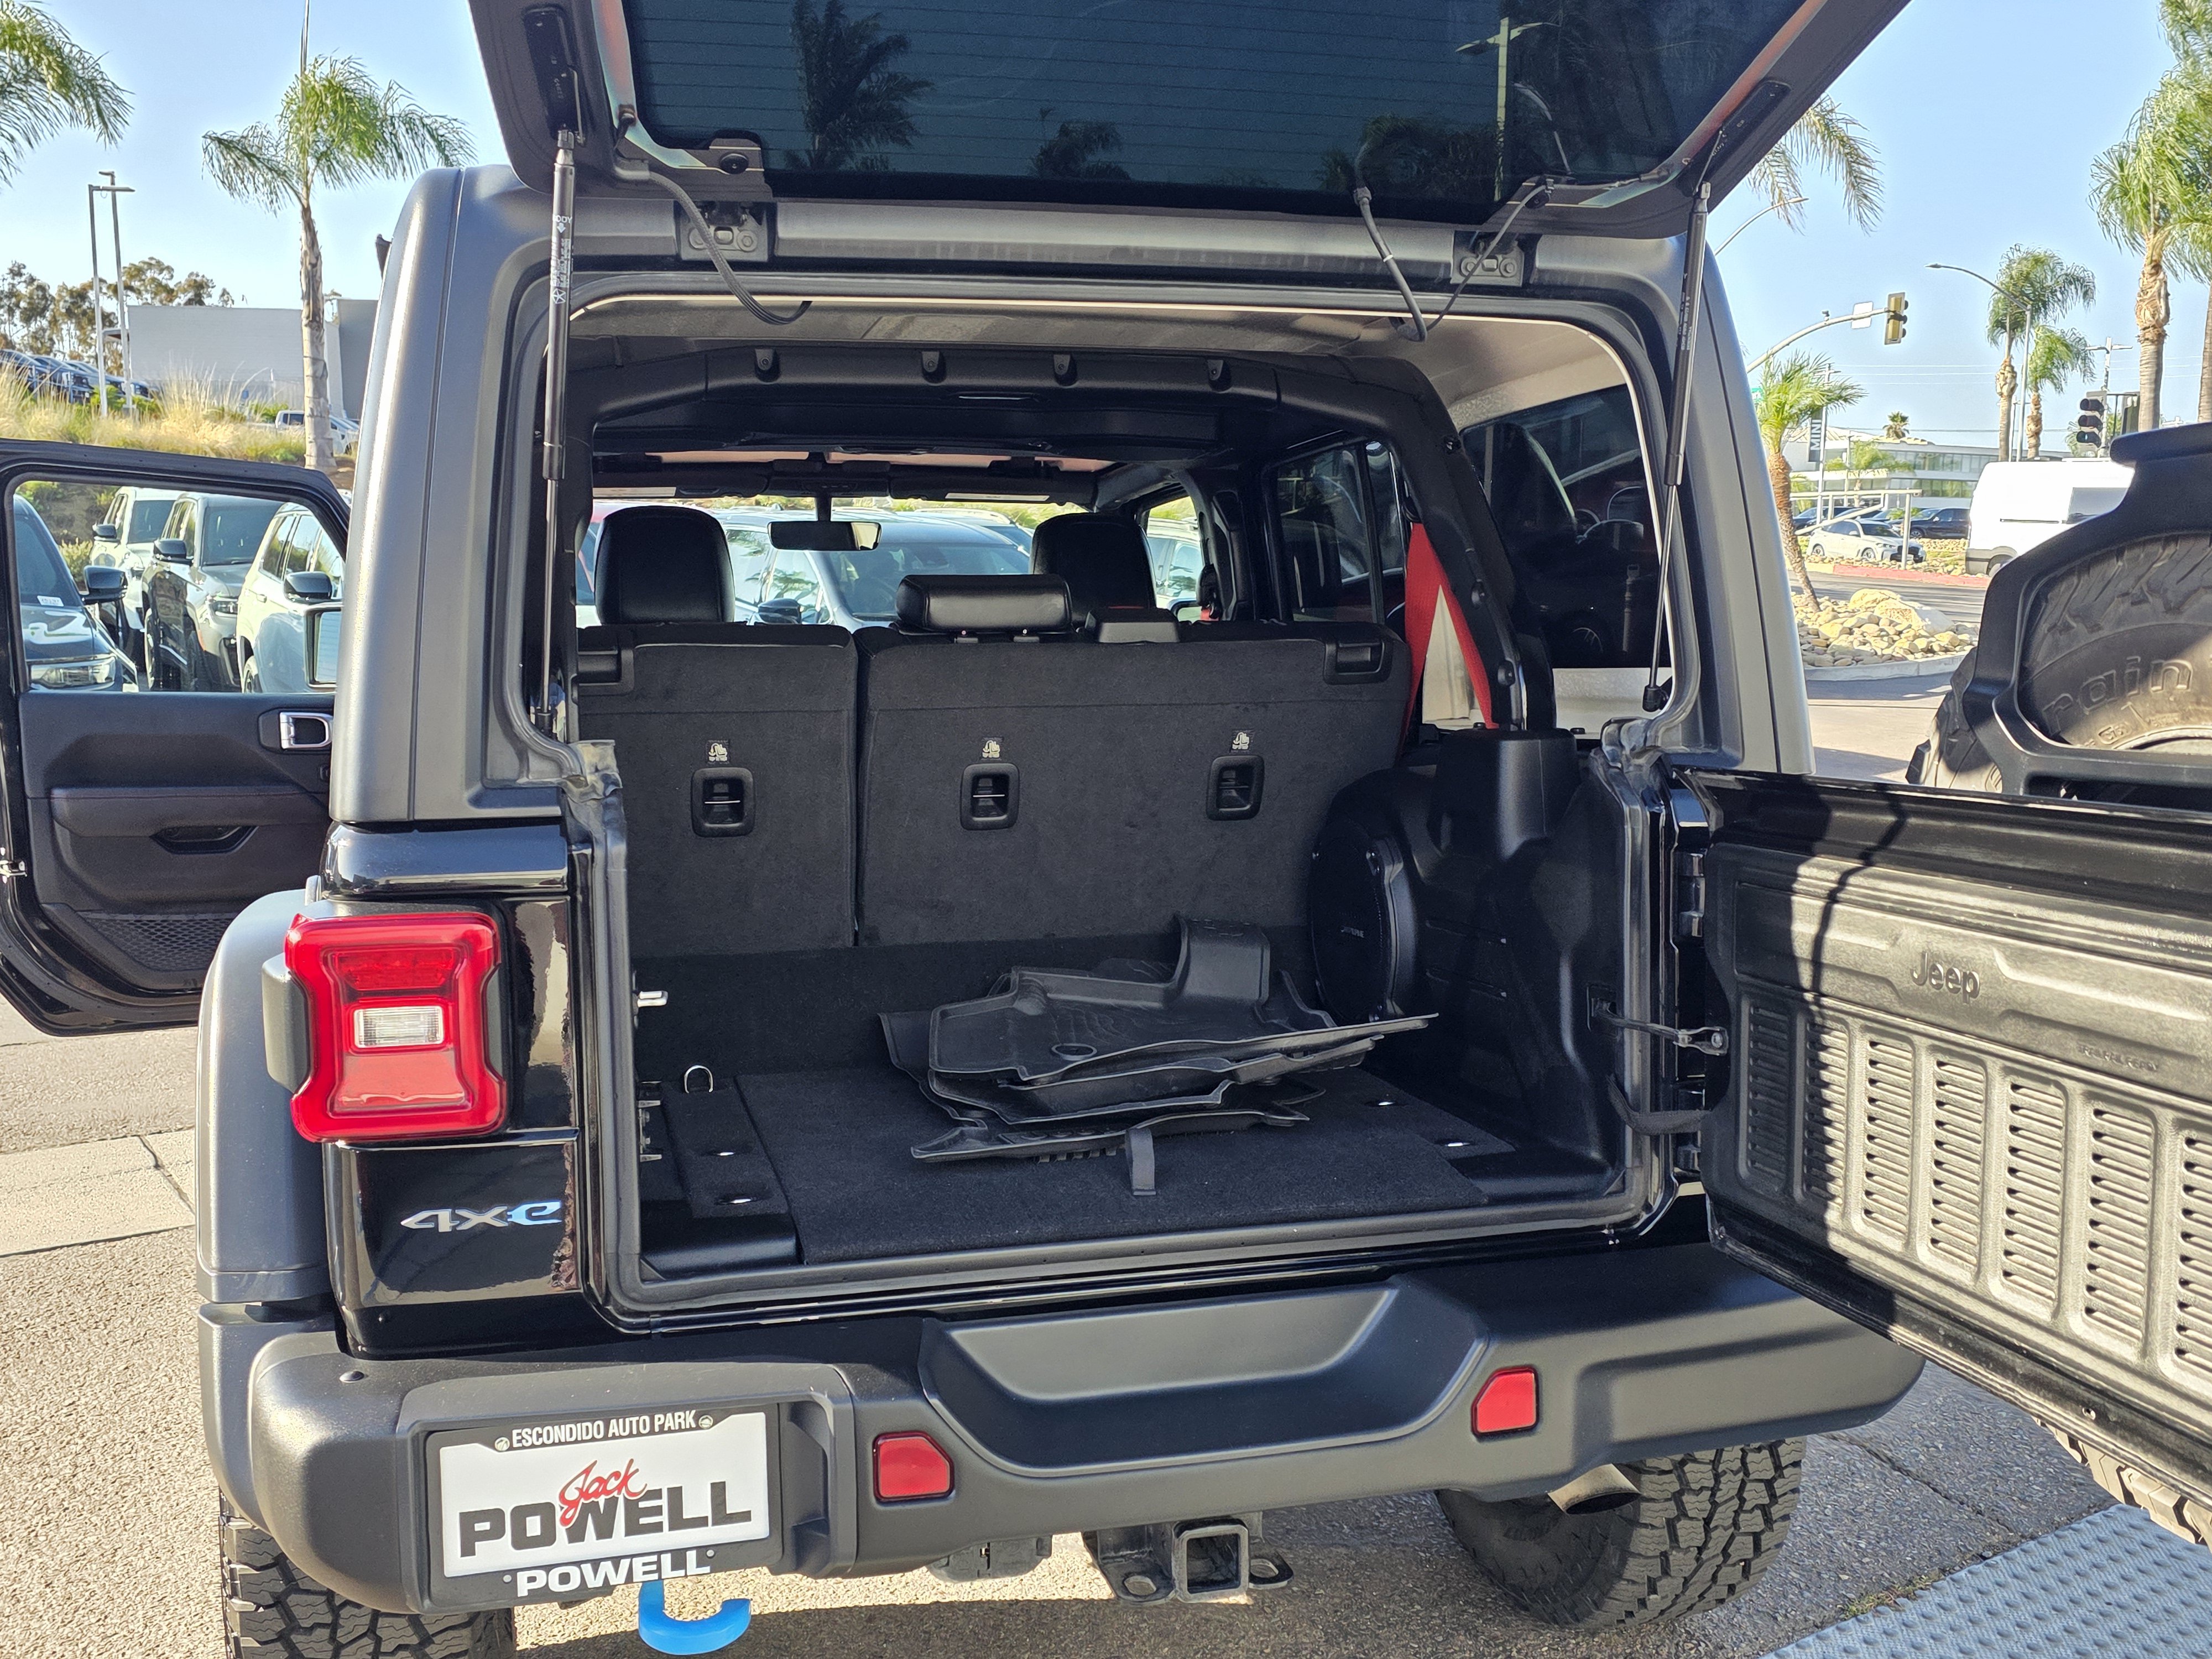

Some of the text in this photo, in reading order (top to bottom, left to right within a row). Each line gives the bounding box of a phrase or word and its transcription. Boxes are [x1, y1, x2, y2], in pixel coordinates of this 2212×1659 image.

[1810, 419, 1822, 450] MINI
[1910, 950, 1981, 1005] Jeep
[512, 1409, 697, 1448] ESCONDIDO AUTO PARK
[559, 1458, 648, 1527] Jack
[459, 1481, 752, 1558] POWELL
[517, 1550, 711, 1598] POWELL
